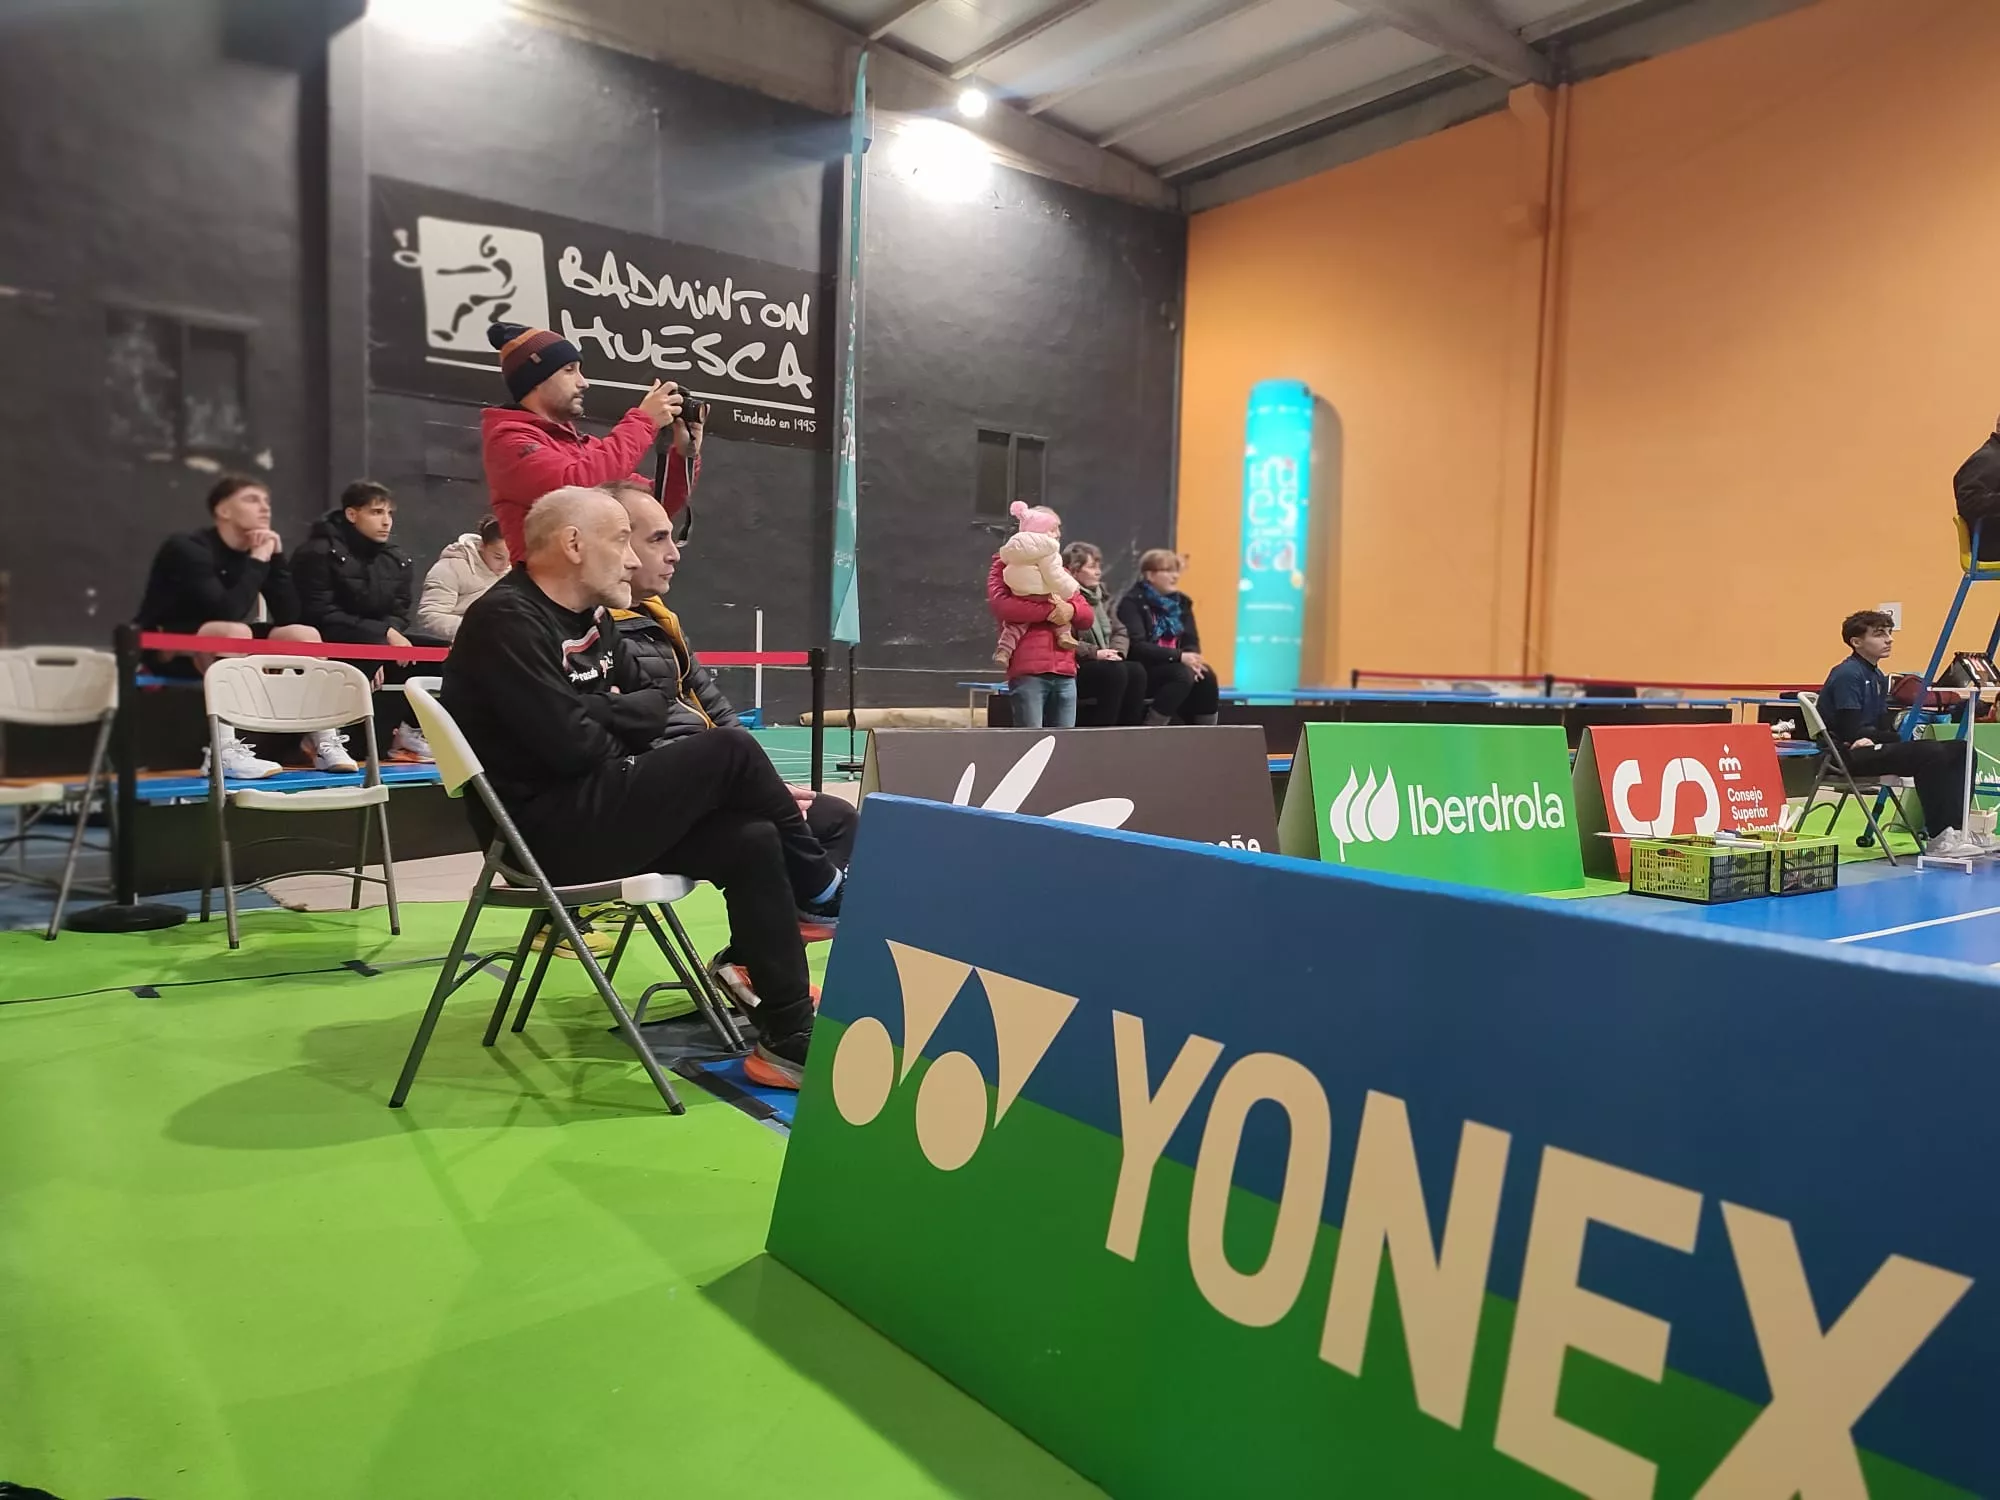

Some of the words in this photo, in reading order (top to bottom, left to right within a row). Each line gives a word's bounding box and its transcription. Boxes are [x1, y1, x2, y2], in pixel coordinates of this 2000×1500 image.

[560, 309, 813, 400] HUESCA
[733, 409, 777, 427] Fundado
[779, 420, 790, 429] en
[794, 418, 816, 433] 1995
[1407, 782, 1565, 836] Iberdrola
[1727, 785, 1763, 807] Consejo
[1731, 805, 1769, 822] Superior
[1105, 1010, 1975, 1500] YONEX
